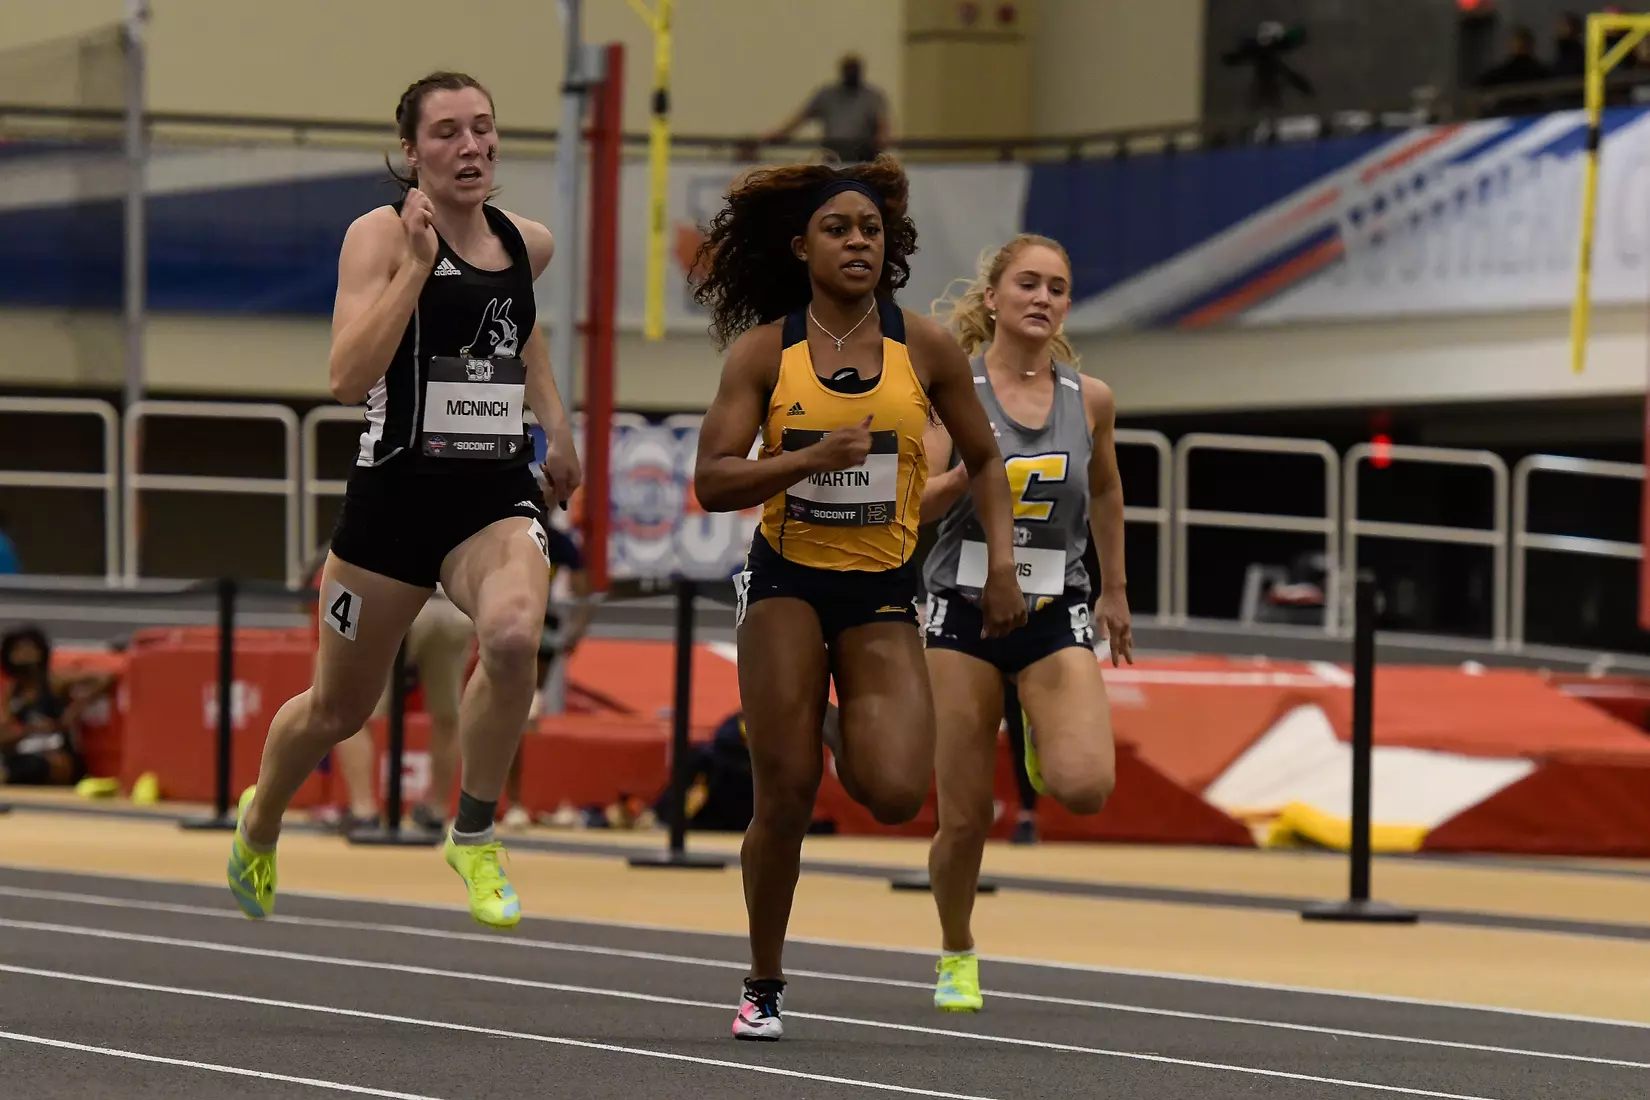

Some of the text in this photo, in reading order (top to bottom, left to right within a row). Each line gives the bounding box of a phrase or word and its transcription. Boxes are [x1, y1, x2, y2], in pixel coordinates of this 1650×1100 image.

[446, 400, 509, 417] MCNINCH
[808, 471, 869, 487] MARTIN
[1004, 451, 1070, 522] C
[330, 591, 352, 634] 4
